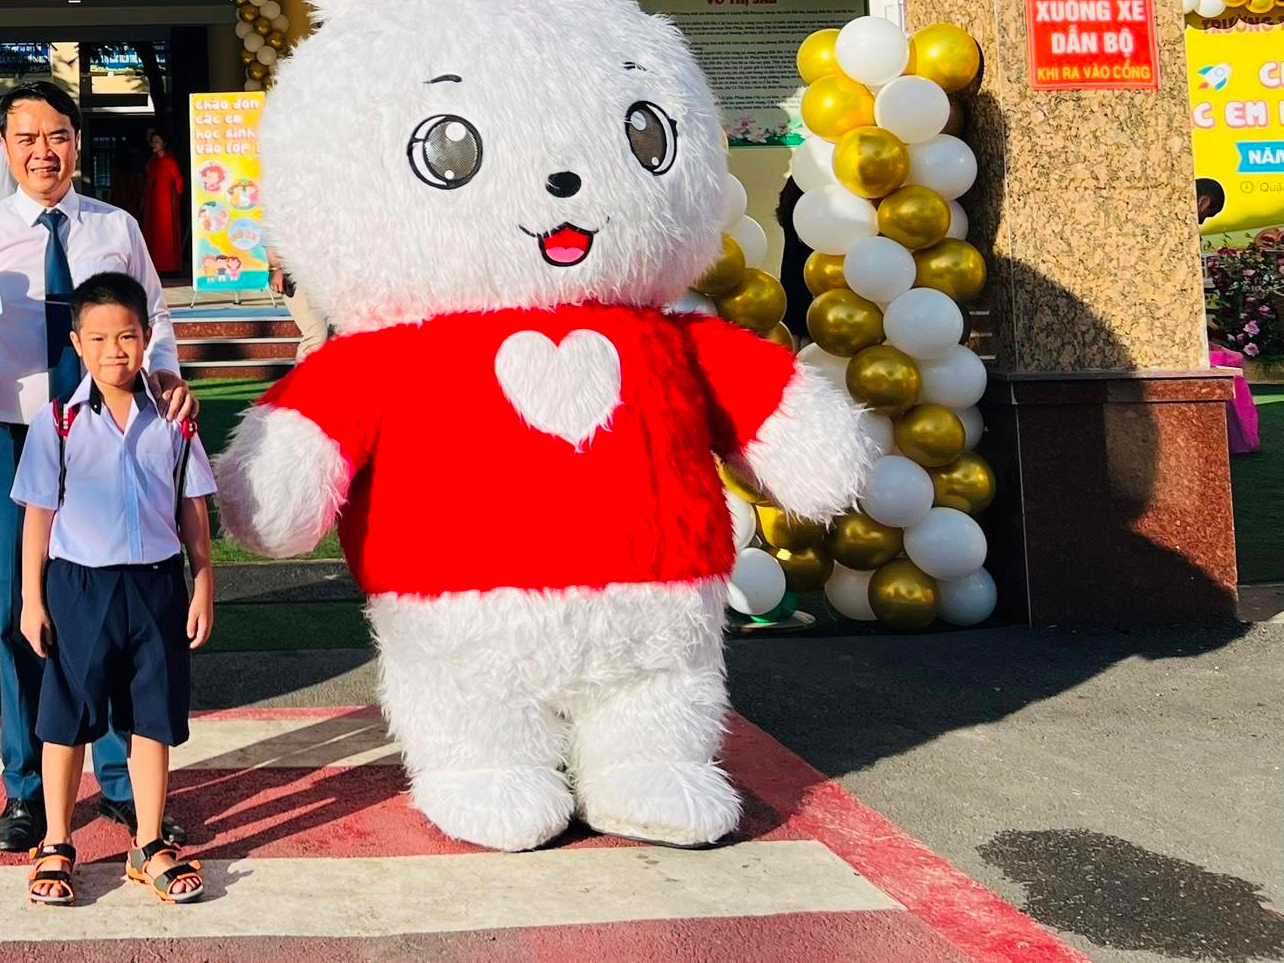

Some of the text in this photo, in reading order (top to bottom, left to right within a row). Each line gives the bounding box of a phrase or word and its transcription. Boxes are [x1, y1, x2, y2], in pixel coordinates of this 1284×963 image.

[1117, 0, 1145, 21] XE
[1051, 24, 1134, 57] DẪN BỘ
[1037, 67, 1059, 80] KHI
[1062, 67, 1080, 79] RA
[1083, 63, 1110, 79] VÀO
